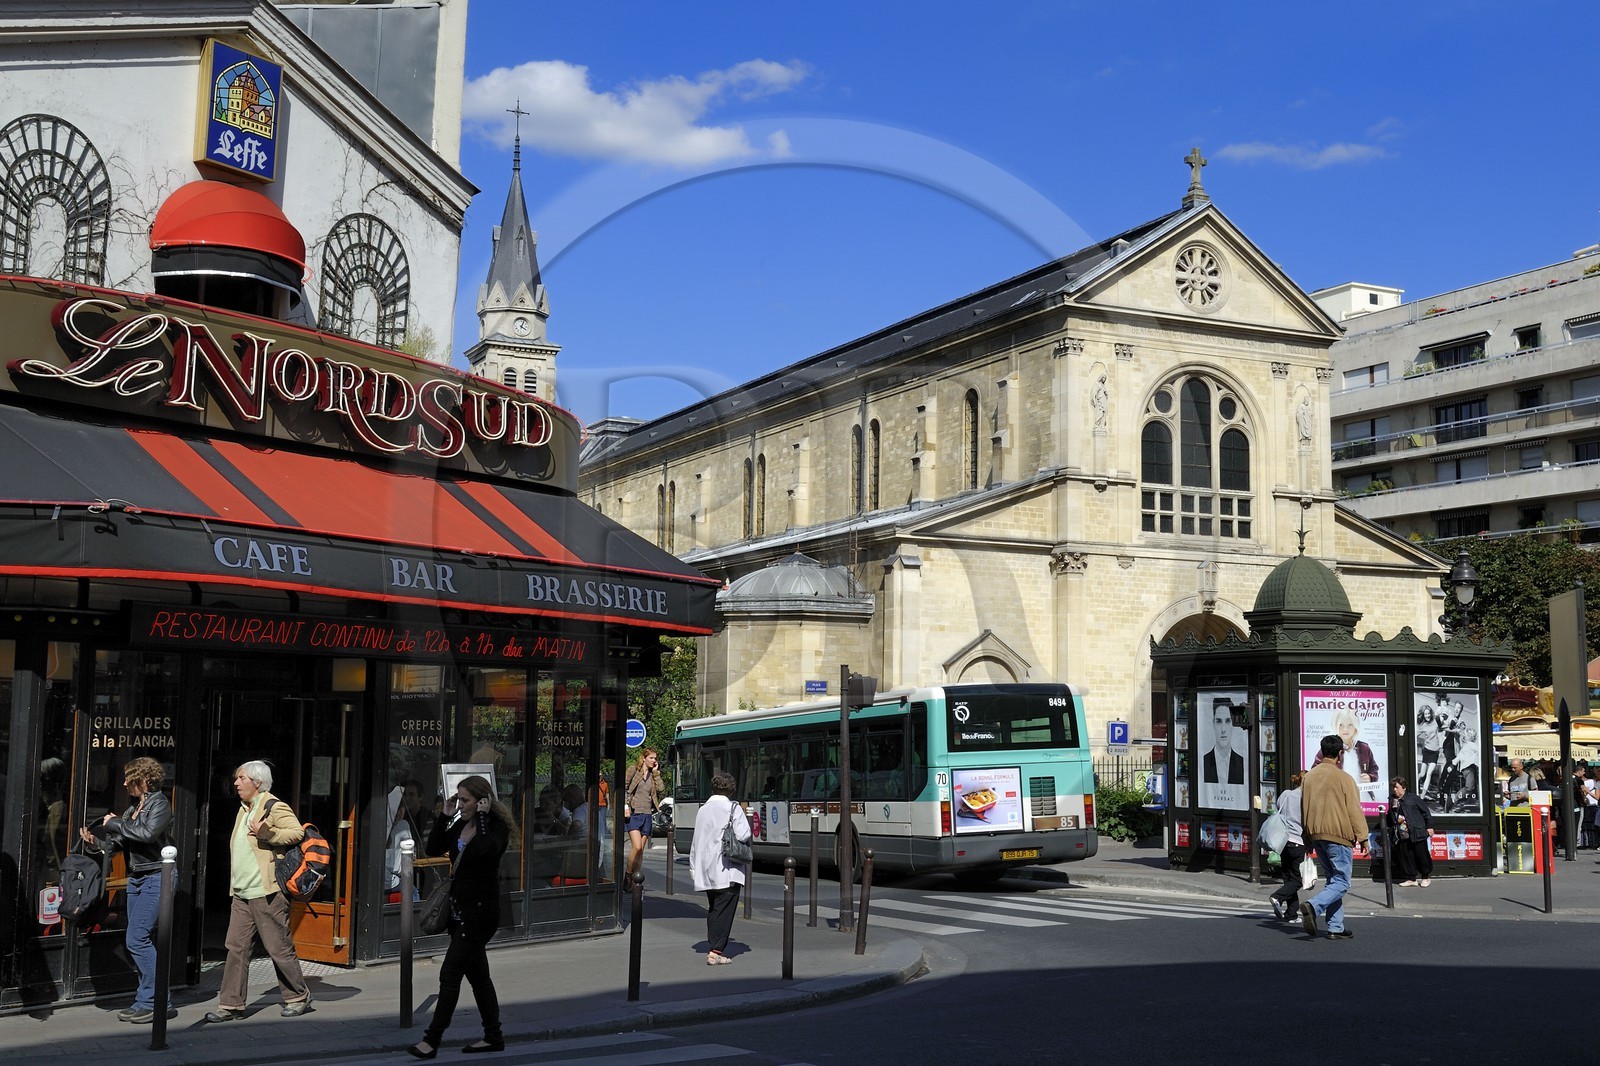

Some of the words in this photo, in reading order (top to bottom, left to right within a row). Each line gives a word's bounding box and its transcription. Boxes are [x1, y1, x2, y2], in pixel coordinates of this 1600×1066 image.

[213, 129, 268, 171] Leffe
[6, 298, 169, 396] Le
[213, 537, 312, 576] CAFE
[389, 557, 458, 594] BAR
[525, 573, 669, 616] BRASSERIE
[150, 611, 305, 644] RESTAURANT
[310, 622, 394, 650] CONTINU
[395, 630, 417, 652] de
[423, 629, 451, 652] 12h
[459, 636, 470, 653] à
[476, 632, 494, 655] 1h
[502, 636, 523, 658] du
[530, 636, 586, 661] MATIN
[1323, 674, 1362, 685] Presse
[1432, 677, 1461, 687] Presse
[1048, 697, 1067, 707] 8494
[1305, 699, 1346, 710] marie
[1347, 699, 1385, 710] claire
[1354, 708, 1385, 721] Enfants
[94, 716, 171, 729] GRILLADES
[401, 719, 443, 731] CREPES
[1114, 726, 1124, 740] P
[92, 734, 100, 748] à
[103, 734, 115, 748] la
[118, 735, 175, 748] PLANCHA
[400, 735, 442, 746] MAISON
[541, 735, 585, 746] CHOCOLAT
[937, 773, 947, 785] 70
[1060, 816, 1073, 827] 85
